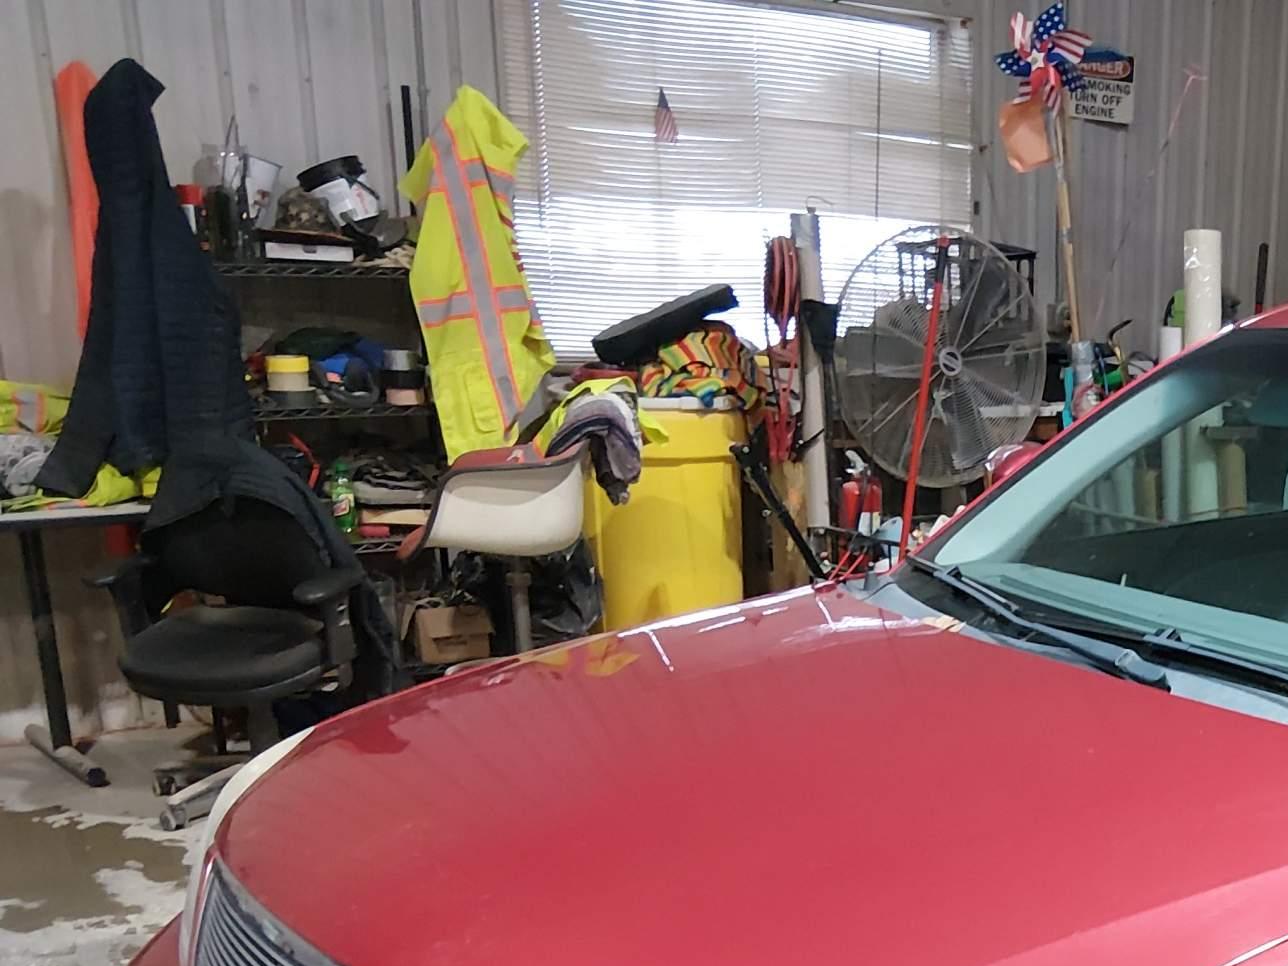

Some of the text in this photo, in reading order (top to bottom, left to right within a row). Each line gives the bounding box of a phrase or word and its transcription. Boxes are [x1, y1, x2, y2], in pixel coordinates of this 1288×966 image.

[1077, 61, 1122, 75] ANGER
[1102, 94, 1122, 106] OFF
[1075, 104, 1115, 119] ENGINE
